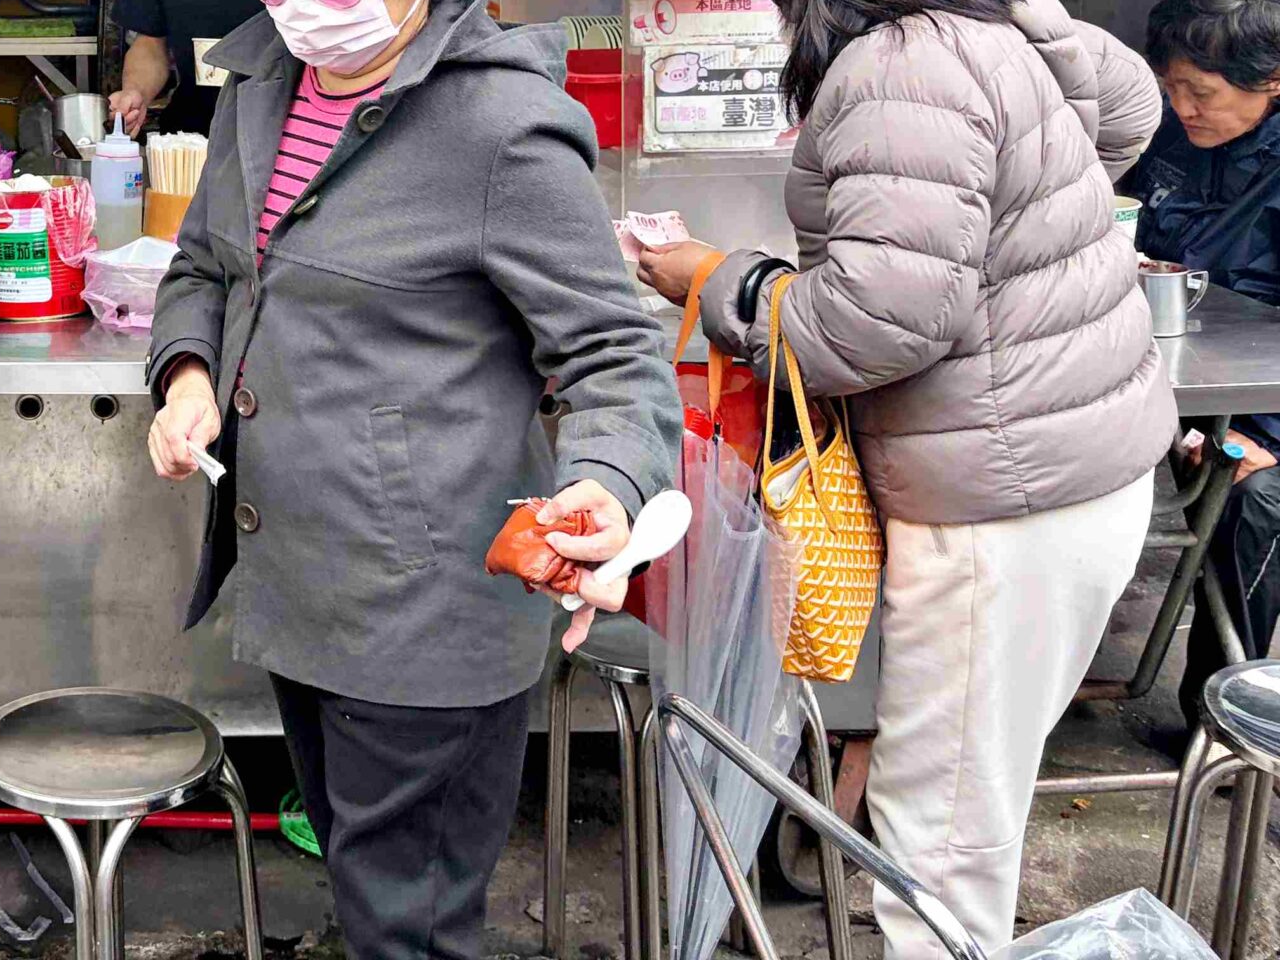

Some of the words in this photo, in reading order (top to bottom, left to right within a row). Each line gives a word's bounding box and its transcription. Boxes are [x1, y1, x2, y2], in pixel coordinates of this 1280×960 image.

[697, 70, 779, 93] 本店使用肉
[721, 96, 776, 127] 臺灣
[634, 215, 658, 229] 100
